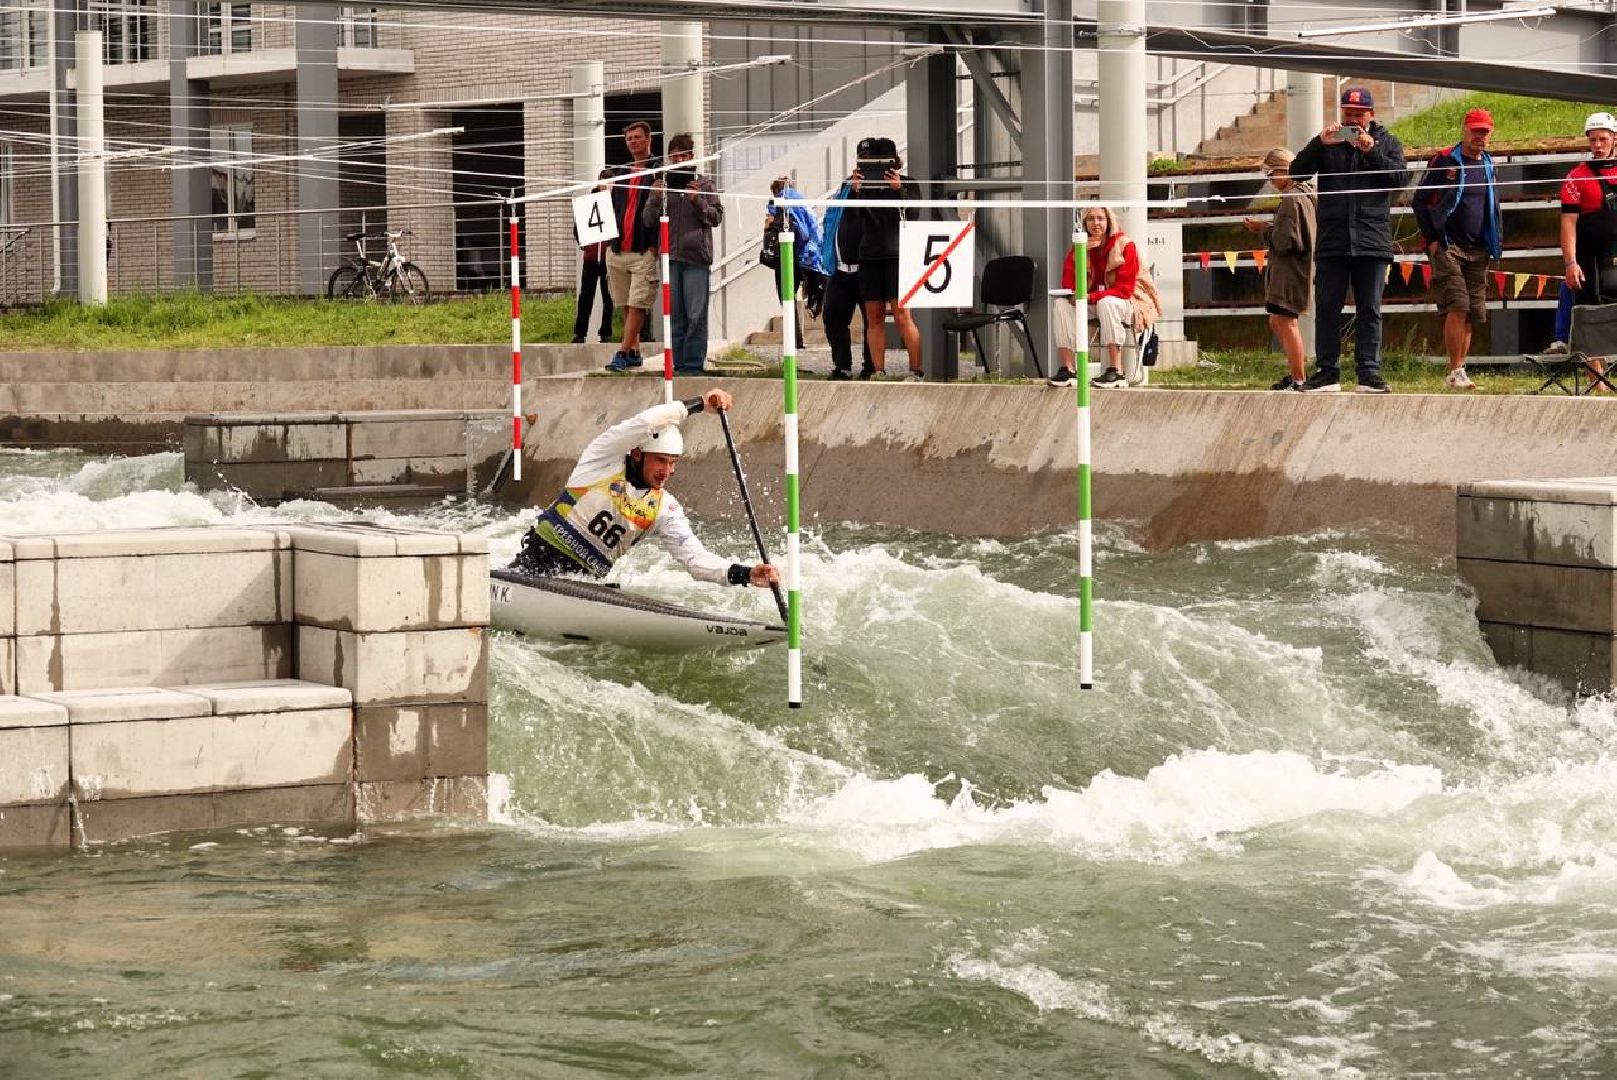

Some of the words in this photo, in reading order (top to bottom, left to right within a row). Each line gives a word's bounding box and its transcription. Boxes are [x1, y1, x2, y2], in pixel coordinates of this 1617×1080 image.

[588, 201, 604, 233] 4
[923, 235, 952, 293] 5
[588, 510, 627, 549] 66
